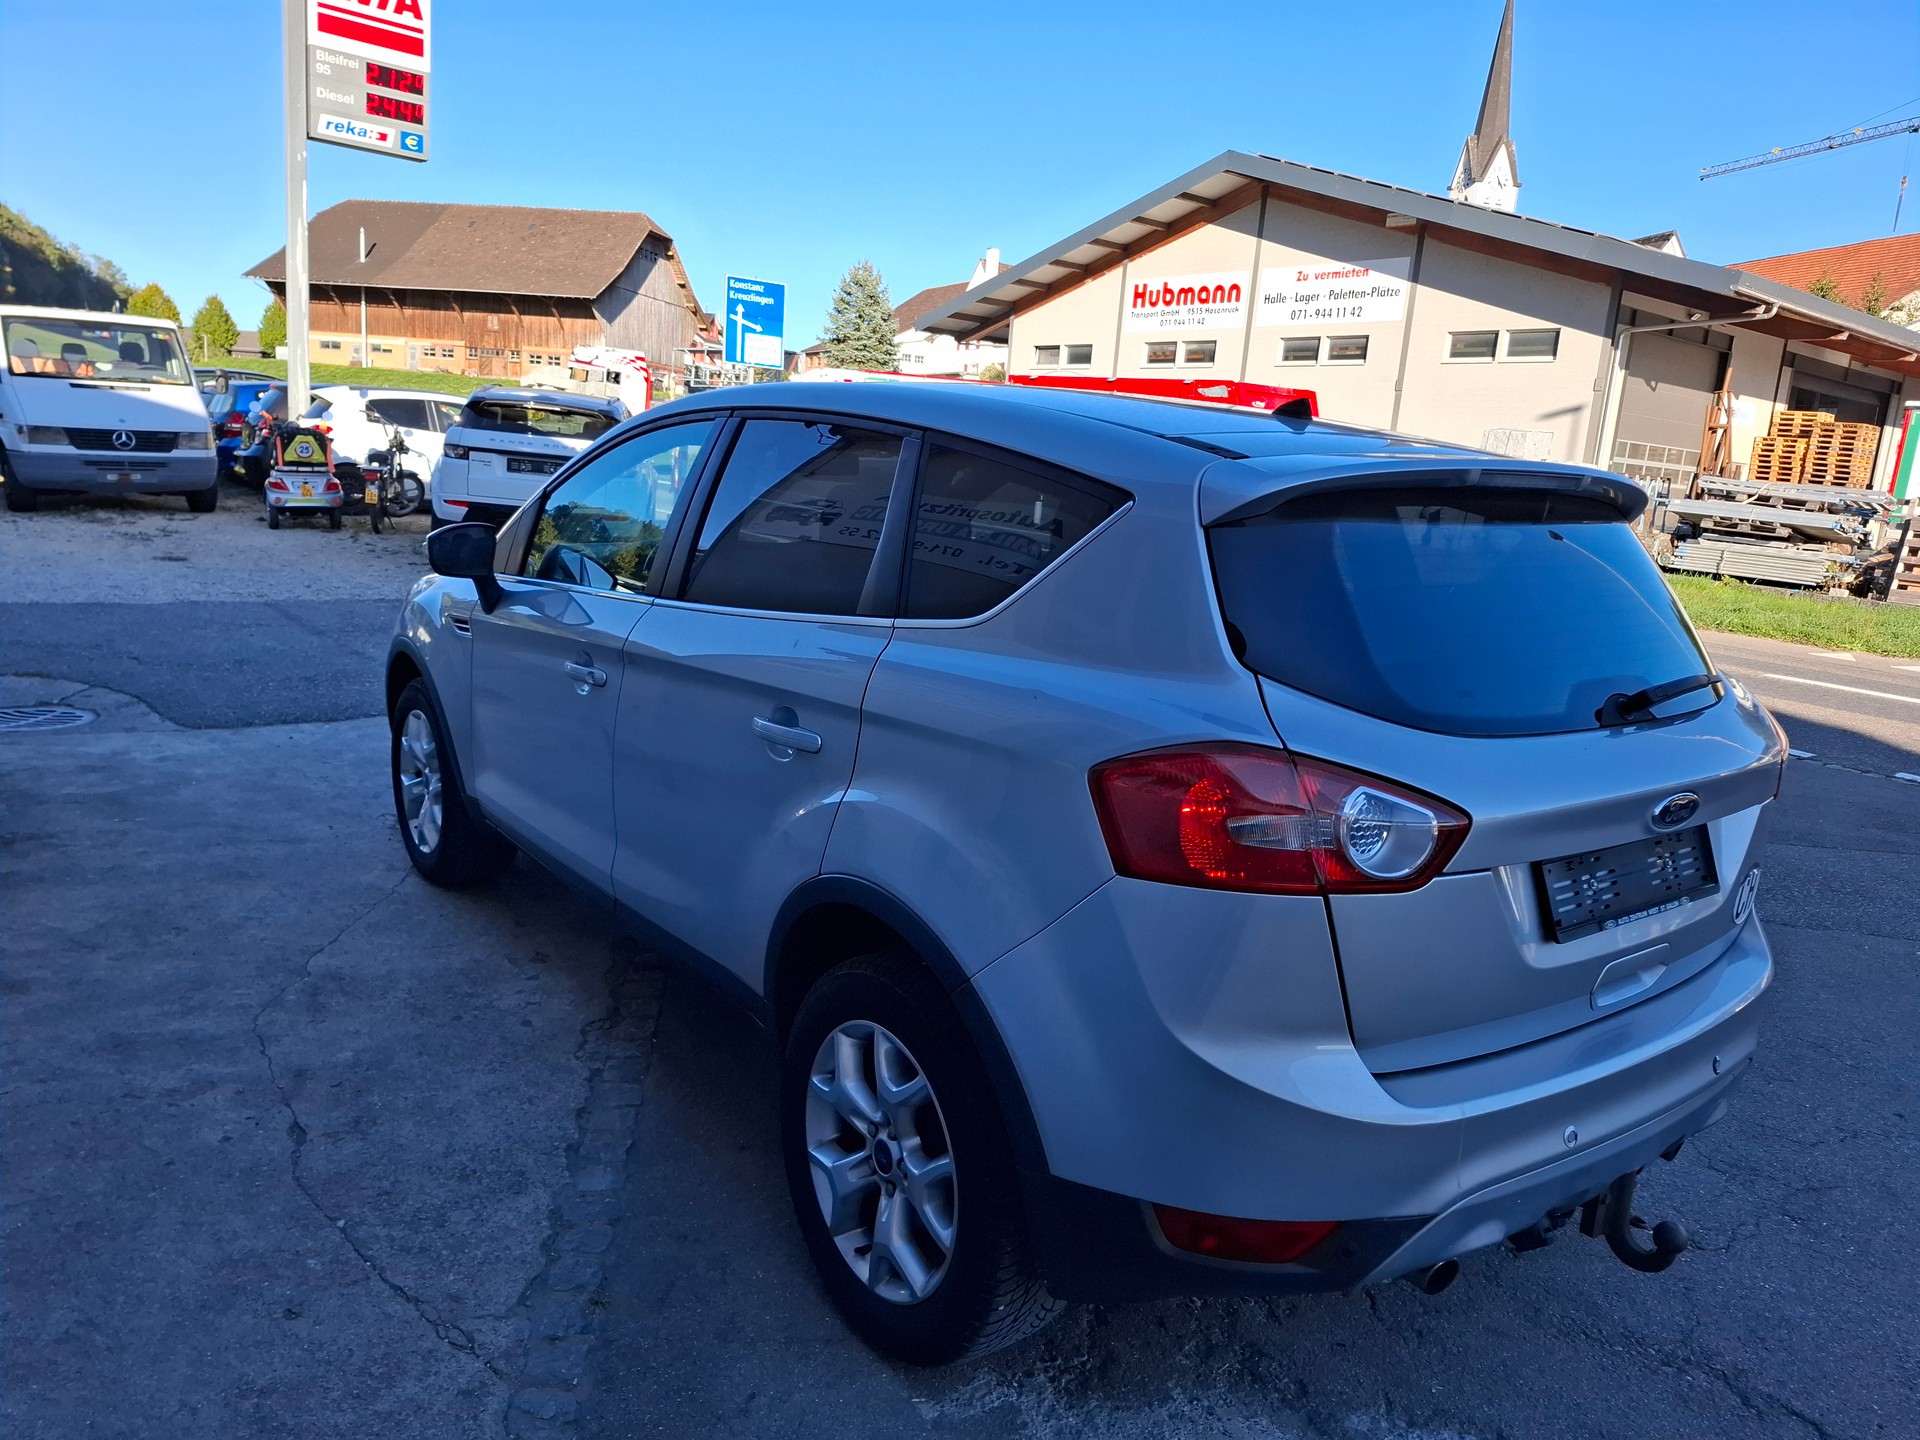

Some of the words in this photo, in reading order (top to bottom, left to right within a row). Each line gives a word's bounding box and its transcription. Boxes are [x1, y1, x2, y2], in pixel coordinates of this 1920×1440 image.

[315, 49, 359, 69] Bleifrei
[315, 63, 332, 75] 95
[316, 87, 354, 104] Diesel
[1296, 271, 1309, 282] Zu
[1314, 267, 1369, 281] vermieten
[729, 279, 765, 292] Konstanz
[729, 290, 775, 305] Kreuzlingen
[1133, 282, 1241, 308] Hubmann
[1263, 292, 1287, 304] Halle
[1294, 292, 1320, 305] Lager
[1328, 286, 1401, 301] Paletten-Plätze
[1131, 311, 1159, 319] Transport
[1160, 309, 1180, 317] GmbH
[1187, 307, 1203, 316] 9515
[1336, 307, 1346, 318] 11
[1350, 306, 1363, 318] 42
[1159, 319, 1171, 327] 071
[1174, 318, 1185, 326] 944
[1188, 317, 1195, 325] 11
[1197, 317, 1206, 325] 42
[299, 445, 310, 454] 25
[1664, 799, 1693, 821] Ford
